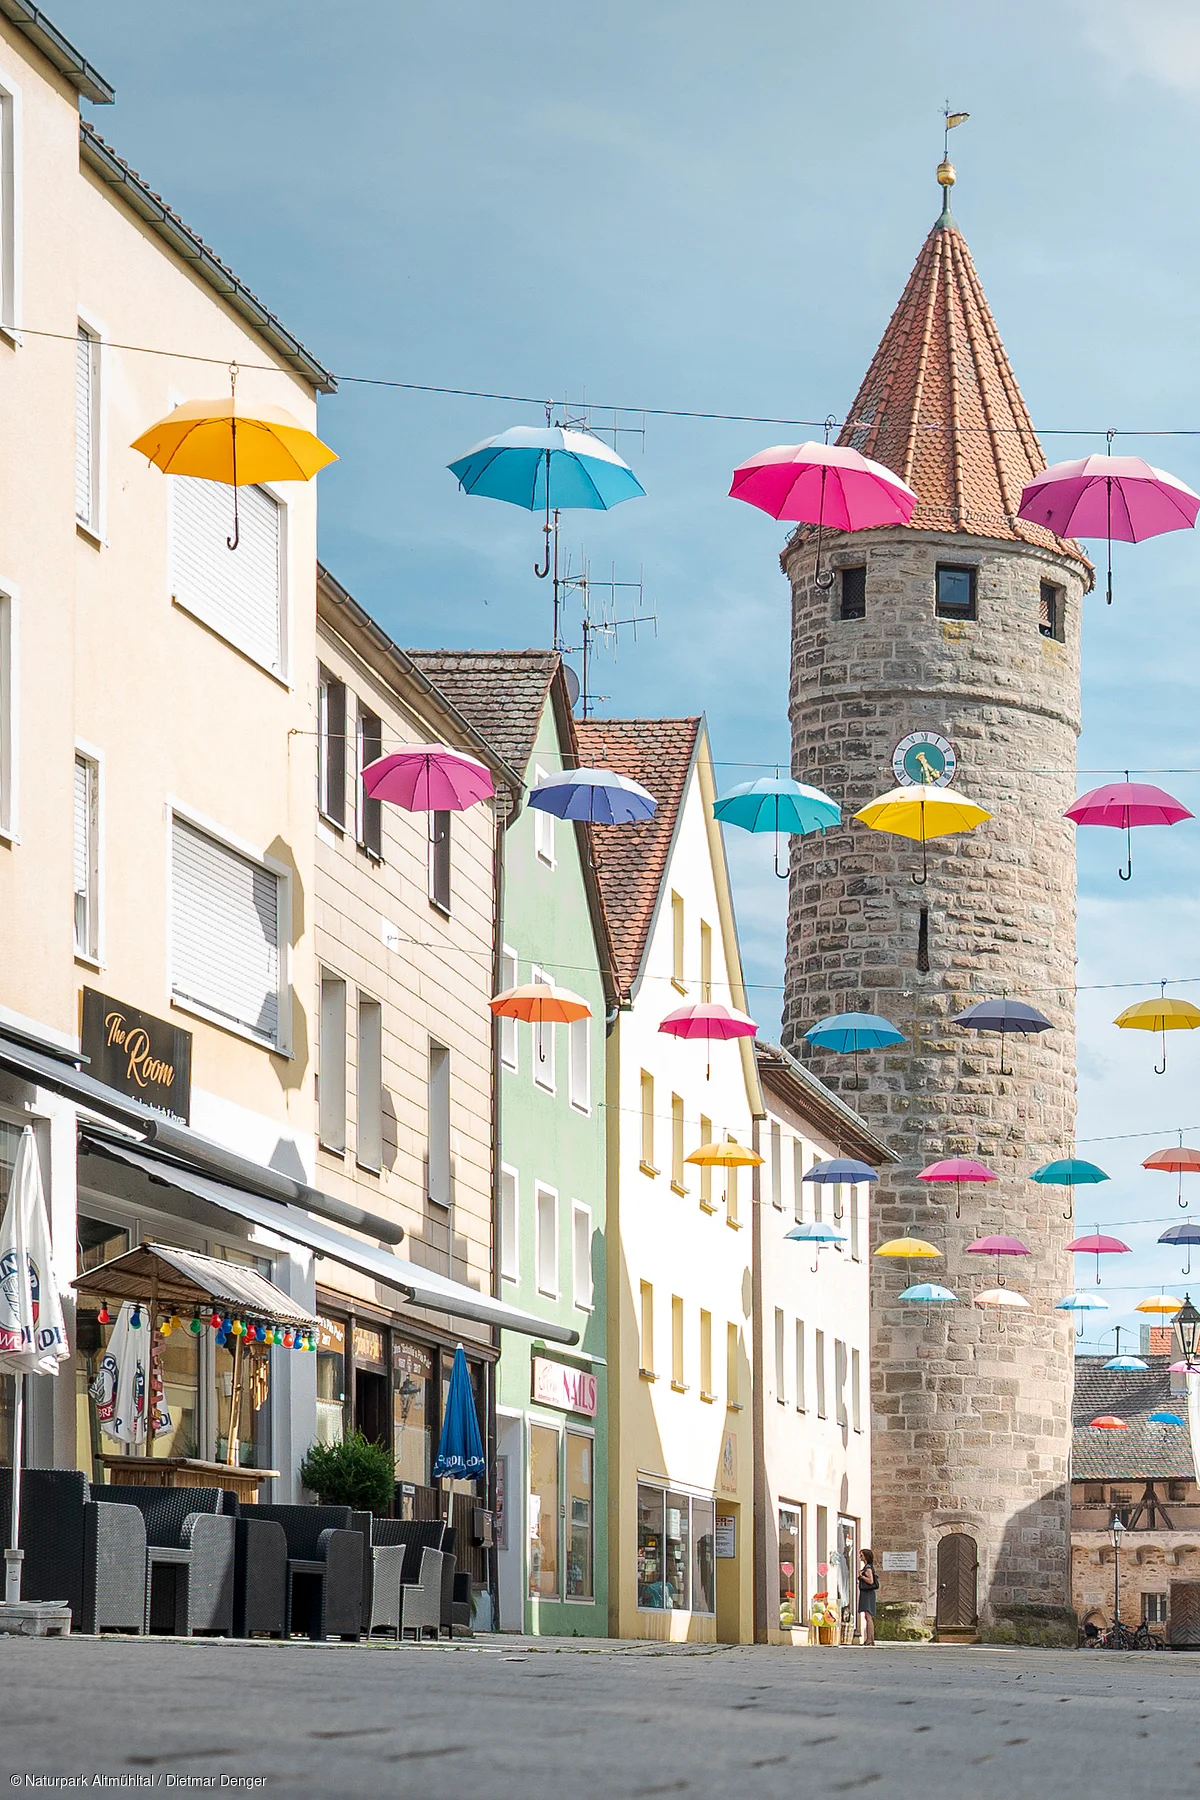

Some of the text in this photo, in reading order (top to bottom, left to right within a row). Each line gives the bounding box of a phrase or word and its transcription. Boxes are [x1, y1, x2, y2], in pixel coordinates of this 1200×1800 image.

[104, 1012, 127, 1047] The
[124, 1027, 175, 1088] Room
[563, 1370, 595, 1411] NAILS
